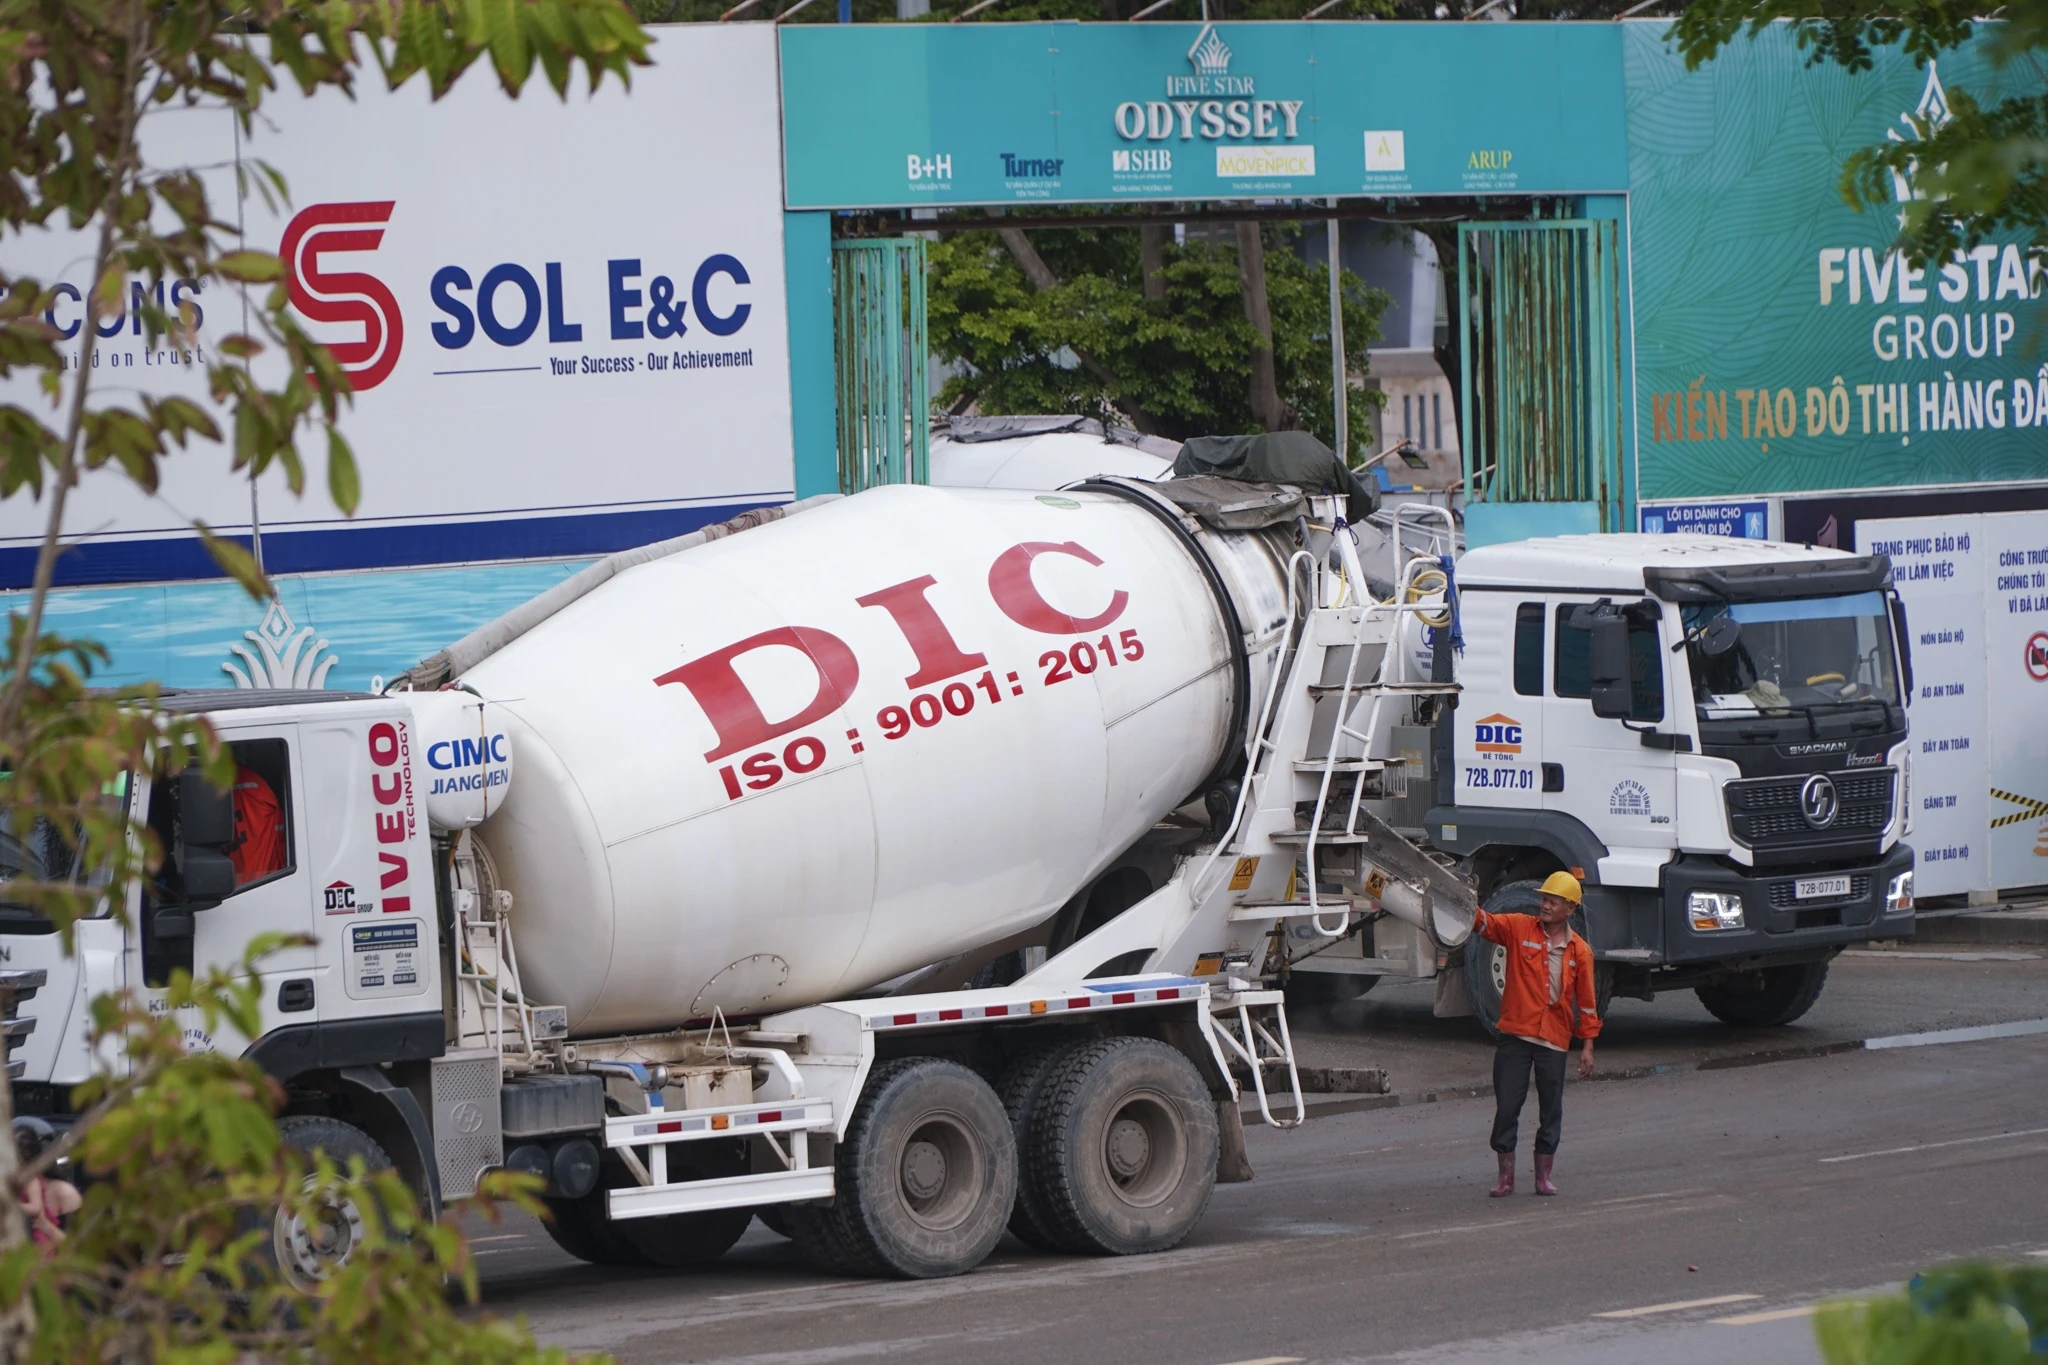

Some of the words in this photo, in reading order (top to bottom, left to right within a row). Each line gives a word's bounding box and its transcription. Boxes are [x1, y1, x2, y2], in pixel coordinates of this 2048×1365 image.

[1174, 76, 1211, 96] FIVE
[1214, 75, 1256, 95] STAR
[1114, 100, 1304, 141] ODYSSEY
[907, 153, 953, 180] B+H
[1000, 153, 1064, 178] Turner
[1131, 149, 1172, 171] SHB
[1218, 154, 1309, 174] MÖVENPICK
[1467, 150, 1513, 169] ARUP
[1818, 247, 1928, 306] FIVE
[430, 264, 583, 350] SOL
[607, 253, 753, 342] E&C
[1872, 312, 2016, 362] GROUP
[110, 353, 134, 367] on
[145, 344, 205, 365] trust
[550, 356, 578, 376] Your
[581, 354, 635, 374] Success
[647, 352, 670, 371] Our
[672, 348, 754, 370] Achievement
[1651, 375, 1728, 443] KIẾN
[1735, 387, 1798, 453] TẠO
[1803, 376, 1851, 438] ĐÔ
[1856, 382, 1911, 447] THỊ
[1918, 371, 2006, 432] HÀNG
[1694, 506, 1720, 520] DÀNH
[1720, 507, 1742, 519] CHO
[1871, 540, 1903, 556] TRANG
[1905, 538, 1933, 558] PHỤC
[1935, 532, 1955, 553] BẢO
[1957, 532, 1971, 554] HỘ
[1999, 549, 2025, 567] CÔNG
[1908, 562, 1930, 581] LÀM
[1932, 562, 1955, 582] VIỆC
[1997, 572, 2029, 591] CHÚNG
[2031, 570, 2045, 588] TÔI
[2008, 595, 2018, 613] VÌ
[1920, 631, 1936, 646] NÓN
[1938, 628, 1953, 644] BẢO
[1954, 628, 1965, 645] HỘ
[652, 541, 1129, 764] DIC
[1921, 684, 1932, 699] ÁO
[1933, 685, 1944, 697] AN
[1945, 683, 1965, 697] TOÀN
[718, 736, 827, 801] ISO
[1038, 628, 1145, 687] 2015
[1475, 725, 1522, 744] DIC
[1938, 739, 1949, 751] AN
[1950, 736, 1970, 750] TOÀN
[427, 734, 507, 771] CIMC
[1789, 742, 1847, 755] SHACMAN
[429, 768, 509, 795] JIANGMEN
[1945, 795, 1957, 808] TAY
[368, 722, 411, 914] IVECO
[1942, 844, 1958, 860] BẢO
[1958, 844, 1970, 861] HỘ
[324, 887, 356, 910] DIC
